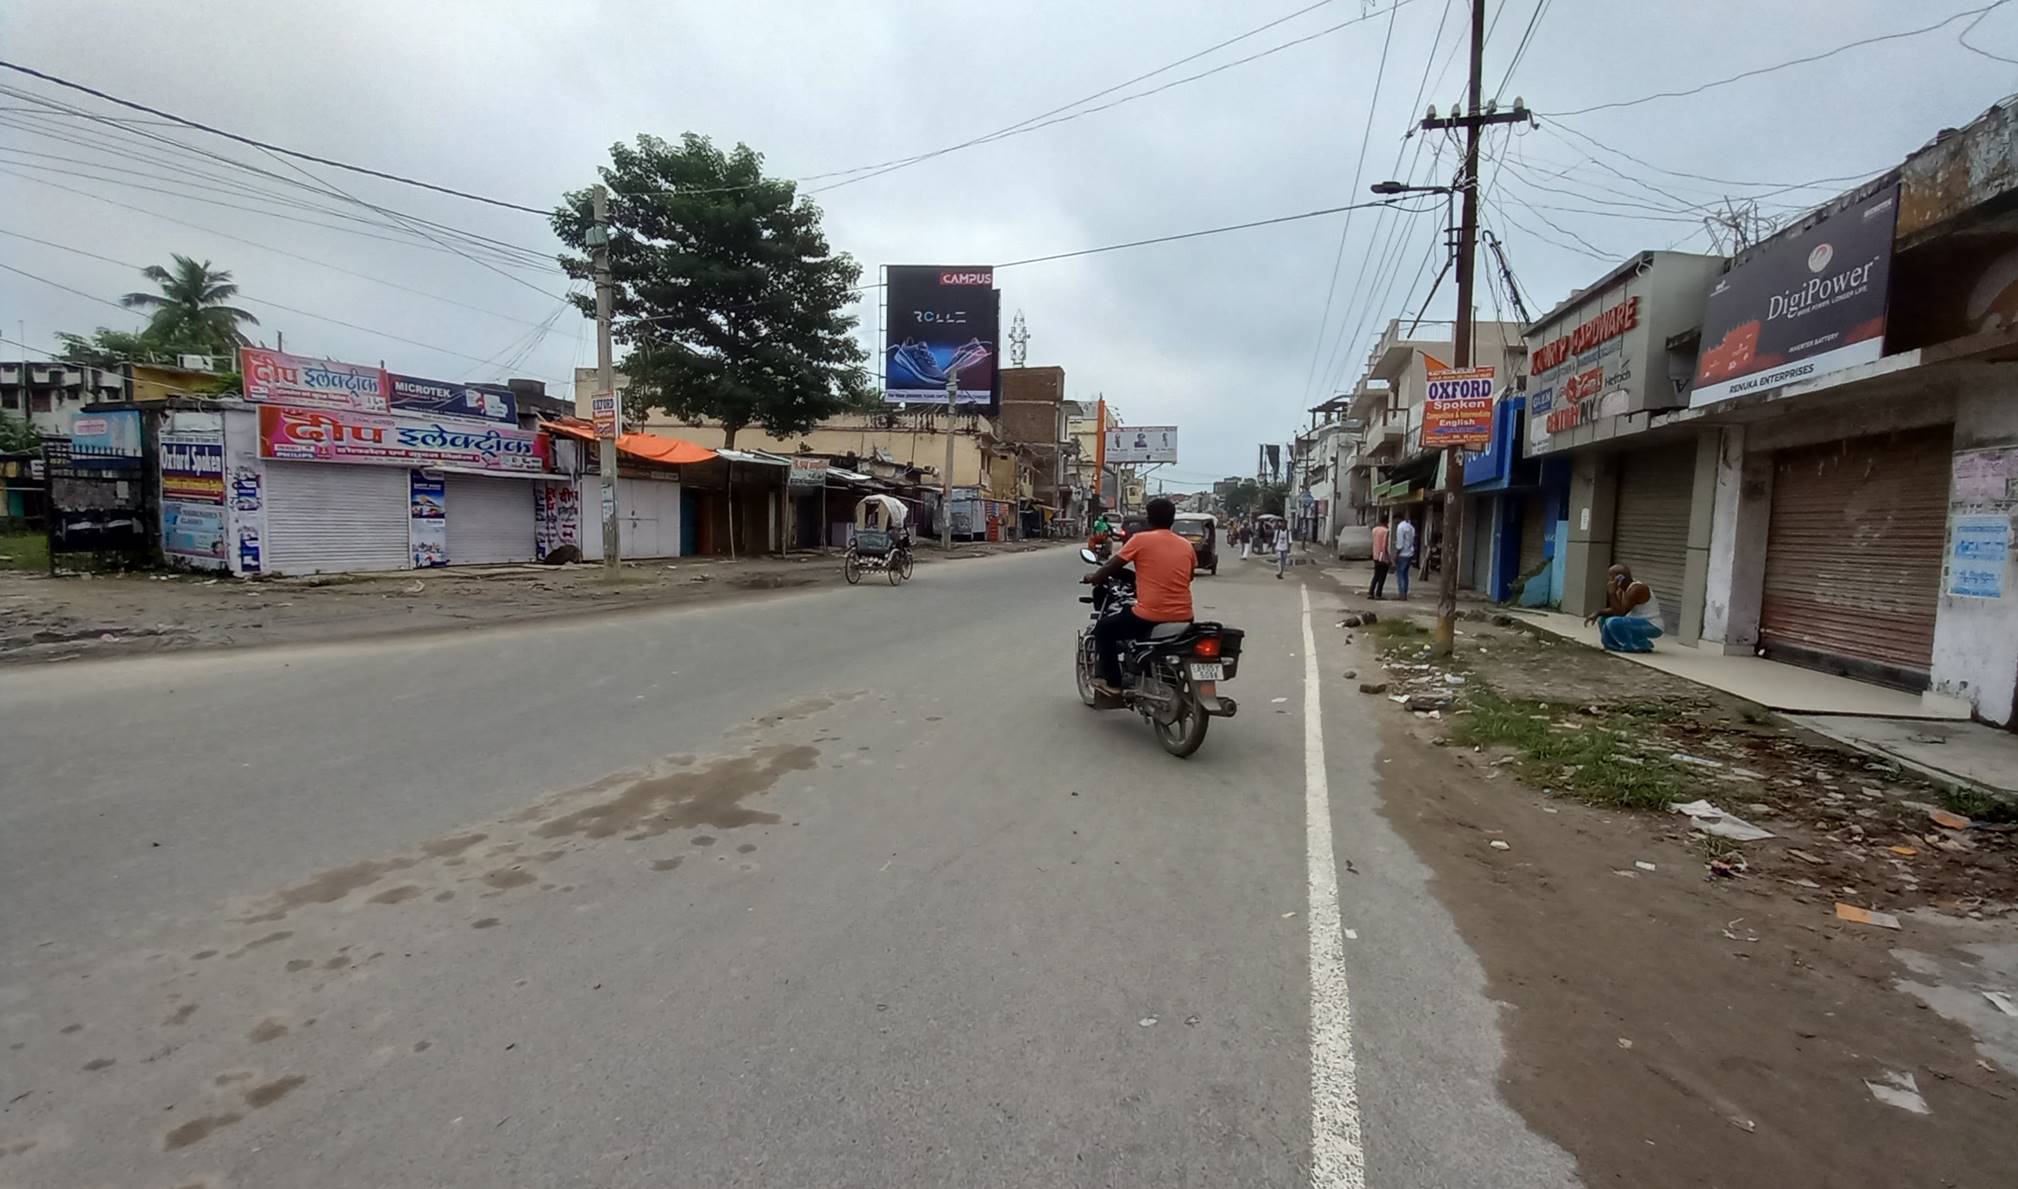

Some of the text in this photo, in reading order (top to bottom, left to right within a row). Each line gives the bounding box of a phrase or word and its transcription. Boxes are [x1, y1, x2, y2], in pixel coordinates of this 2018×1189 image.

[943, 273, 992, 285] CAMPUS
[1767, 261, 1874, 320] DigiPower
[249, 356, 298, 385] दीप
[1729, 364, 1814, 394] RENUKA ENTERPRISES
[395, 382, 451, 397] MICROTEK
[1428, 380, 1491, 400] OXFORD
[1433, 400, 1485, 411] Spoken
[281, 412, 388, 444] दीप
[1439, 418, 1475, 428] English
[162, 445, 221, 477] Oxford Spoken
